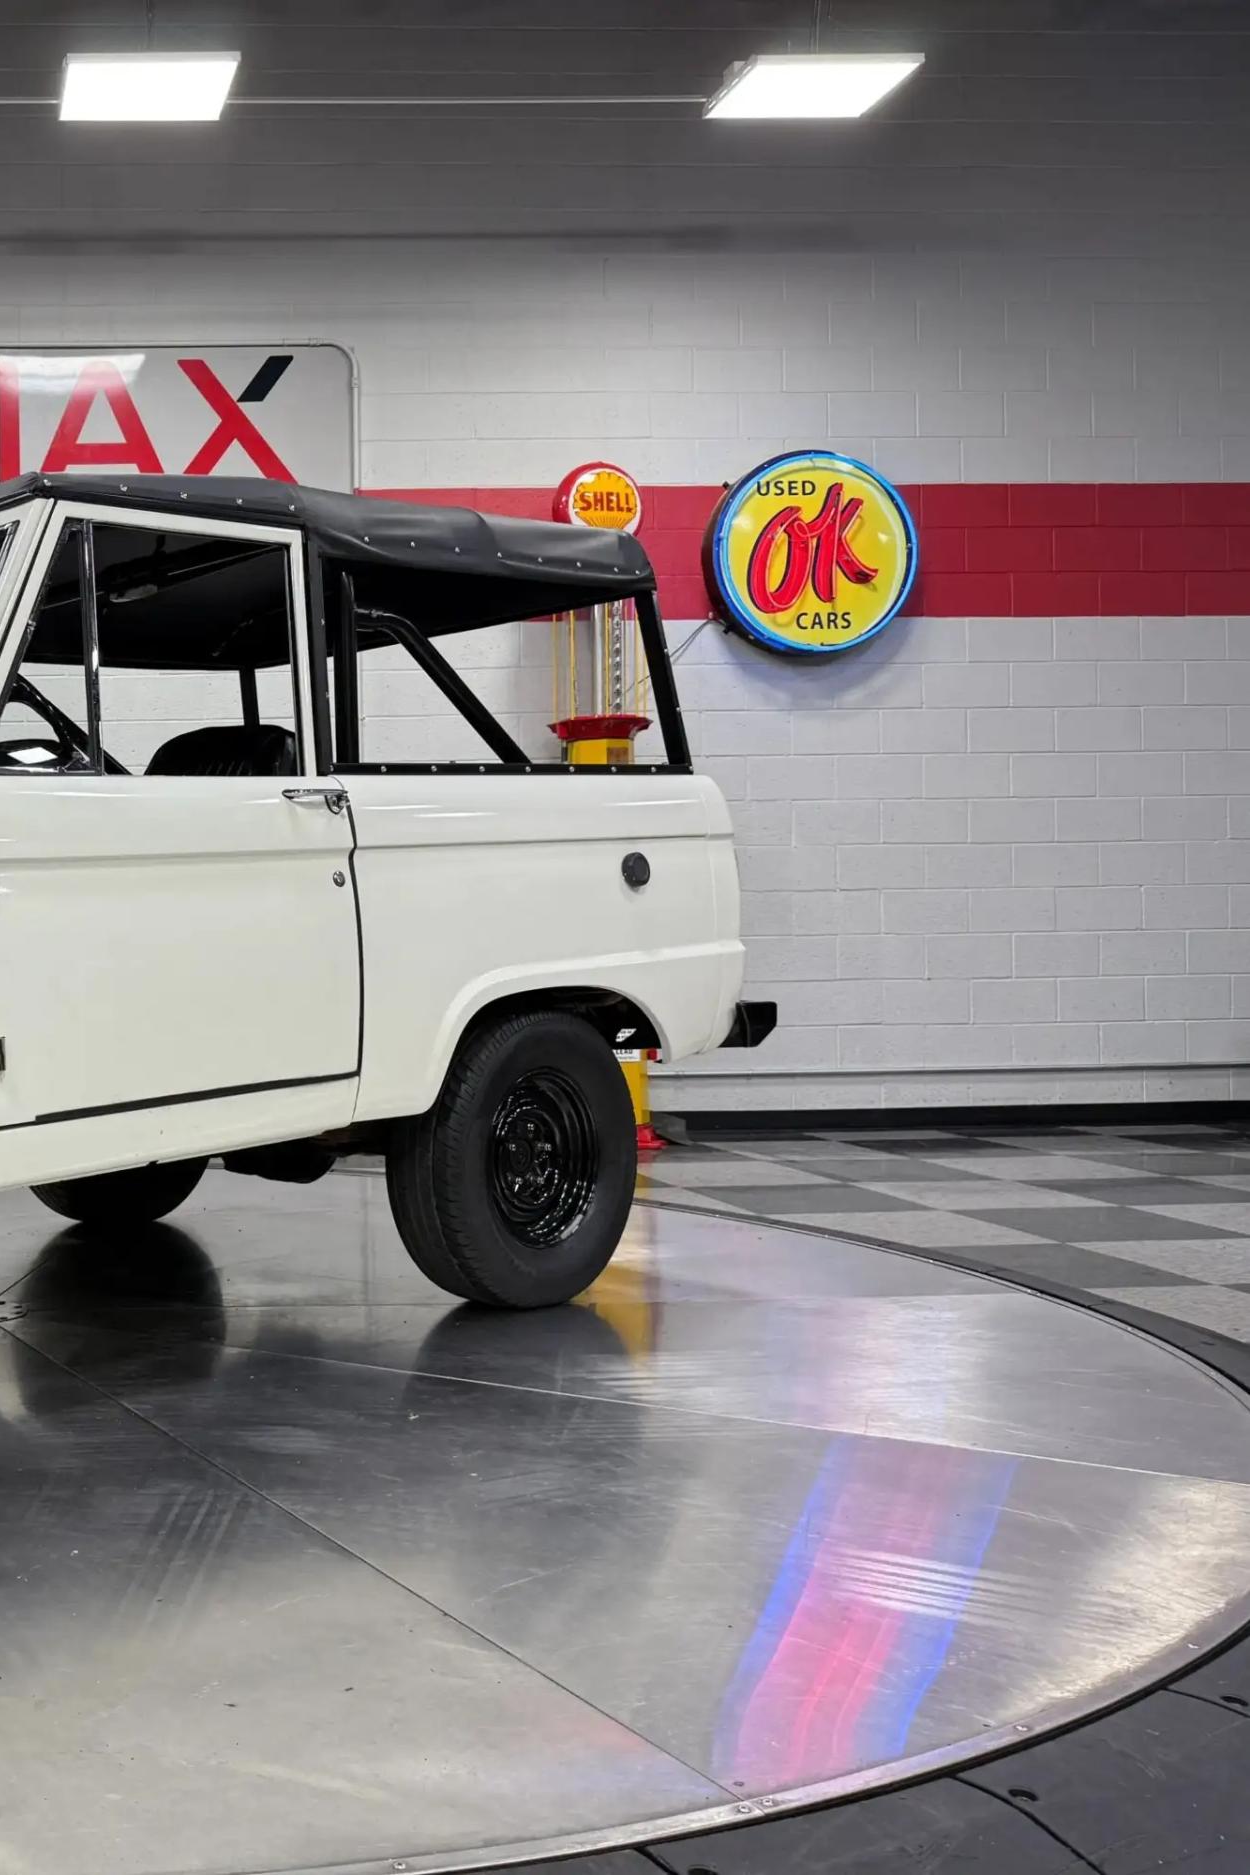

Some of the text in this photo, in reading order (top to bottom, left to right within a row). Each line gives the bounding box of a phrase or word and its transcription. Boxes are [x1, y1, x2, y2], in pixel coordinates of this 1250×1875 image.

[756, 480, 816, 496] USED
[578, 490, 633, 513] SHELL
[746, 482, 878, 614] OK
[796, 612, 852, 630] CARS
